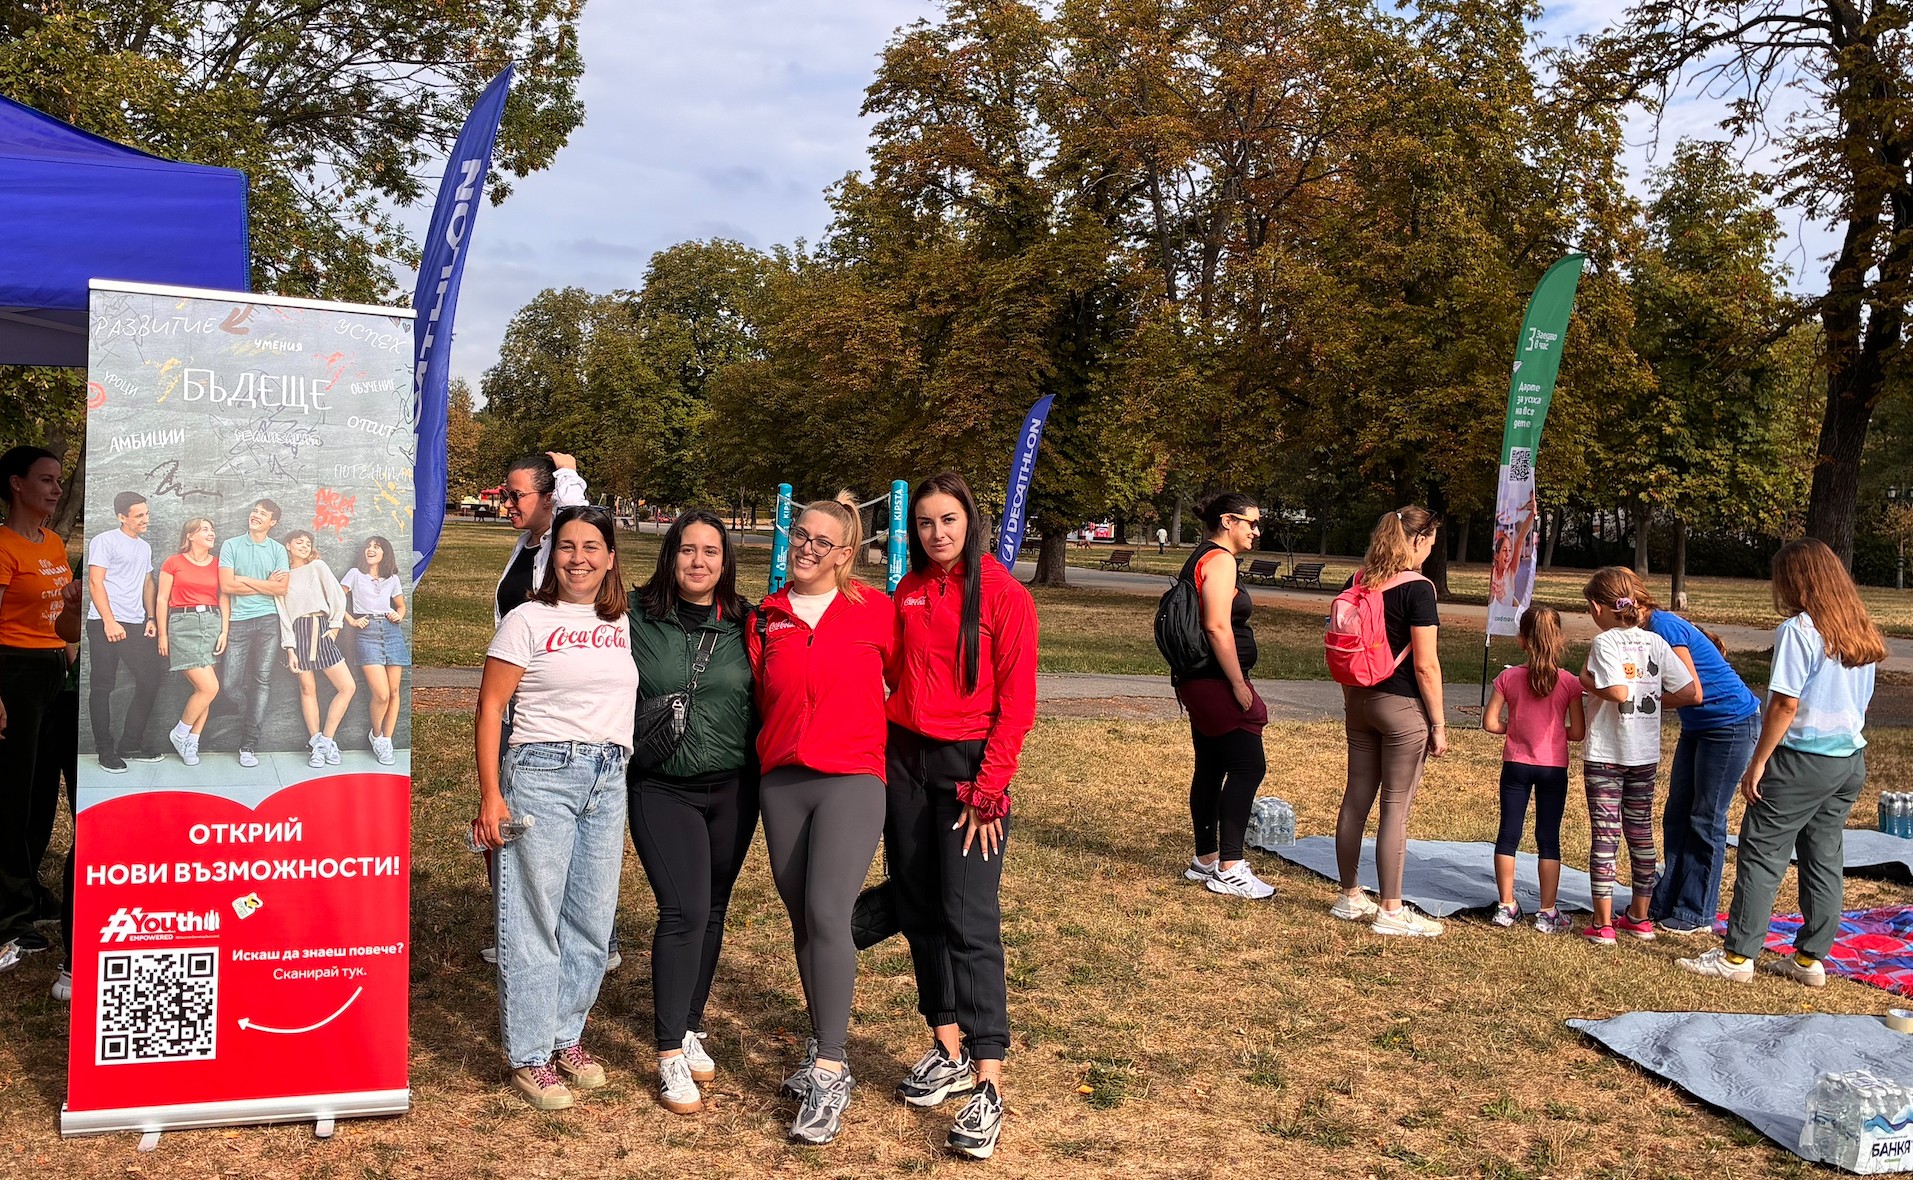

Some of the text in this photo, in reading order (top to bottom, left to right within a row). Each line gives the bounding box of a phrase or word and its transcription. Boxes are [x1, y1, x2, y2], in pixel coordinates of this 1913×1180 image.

[95, 316, 217, 338] РАЗВИТИЕ
[334, 318, 408, 354] УСПЕХ
[103, 370, 140, 398] УРОЦИ
[183, 368, 333, 415] БЪДЕЩЕ
[350, 378, 397, 395] ОБУЧЕНИЕ
[109, 428, 185, 453] АМБИЦИИ
[1006, 418, 1042, 534] DECATHLON
[893, 488, 903, 521] KIPSTA
[545, 623, 627, 652] Coca-Cola
[189, 816, 303, 845] ОТКРИЙ
[86, 855, 400, 886] НОВИ ВЪЗМОЖНОСТИ!
[129, 933, 174, 942] EMPOWERED
[232, 942, 404, 961] Искаш да знаеш повече?
[273, 965, 367, 981] Сканирай тук.
[1871, 1139, 1911, 1158] БАНКЯ
